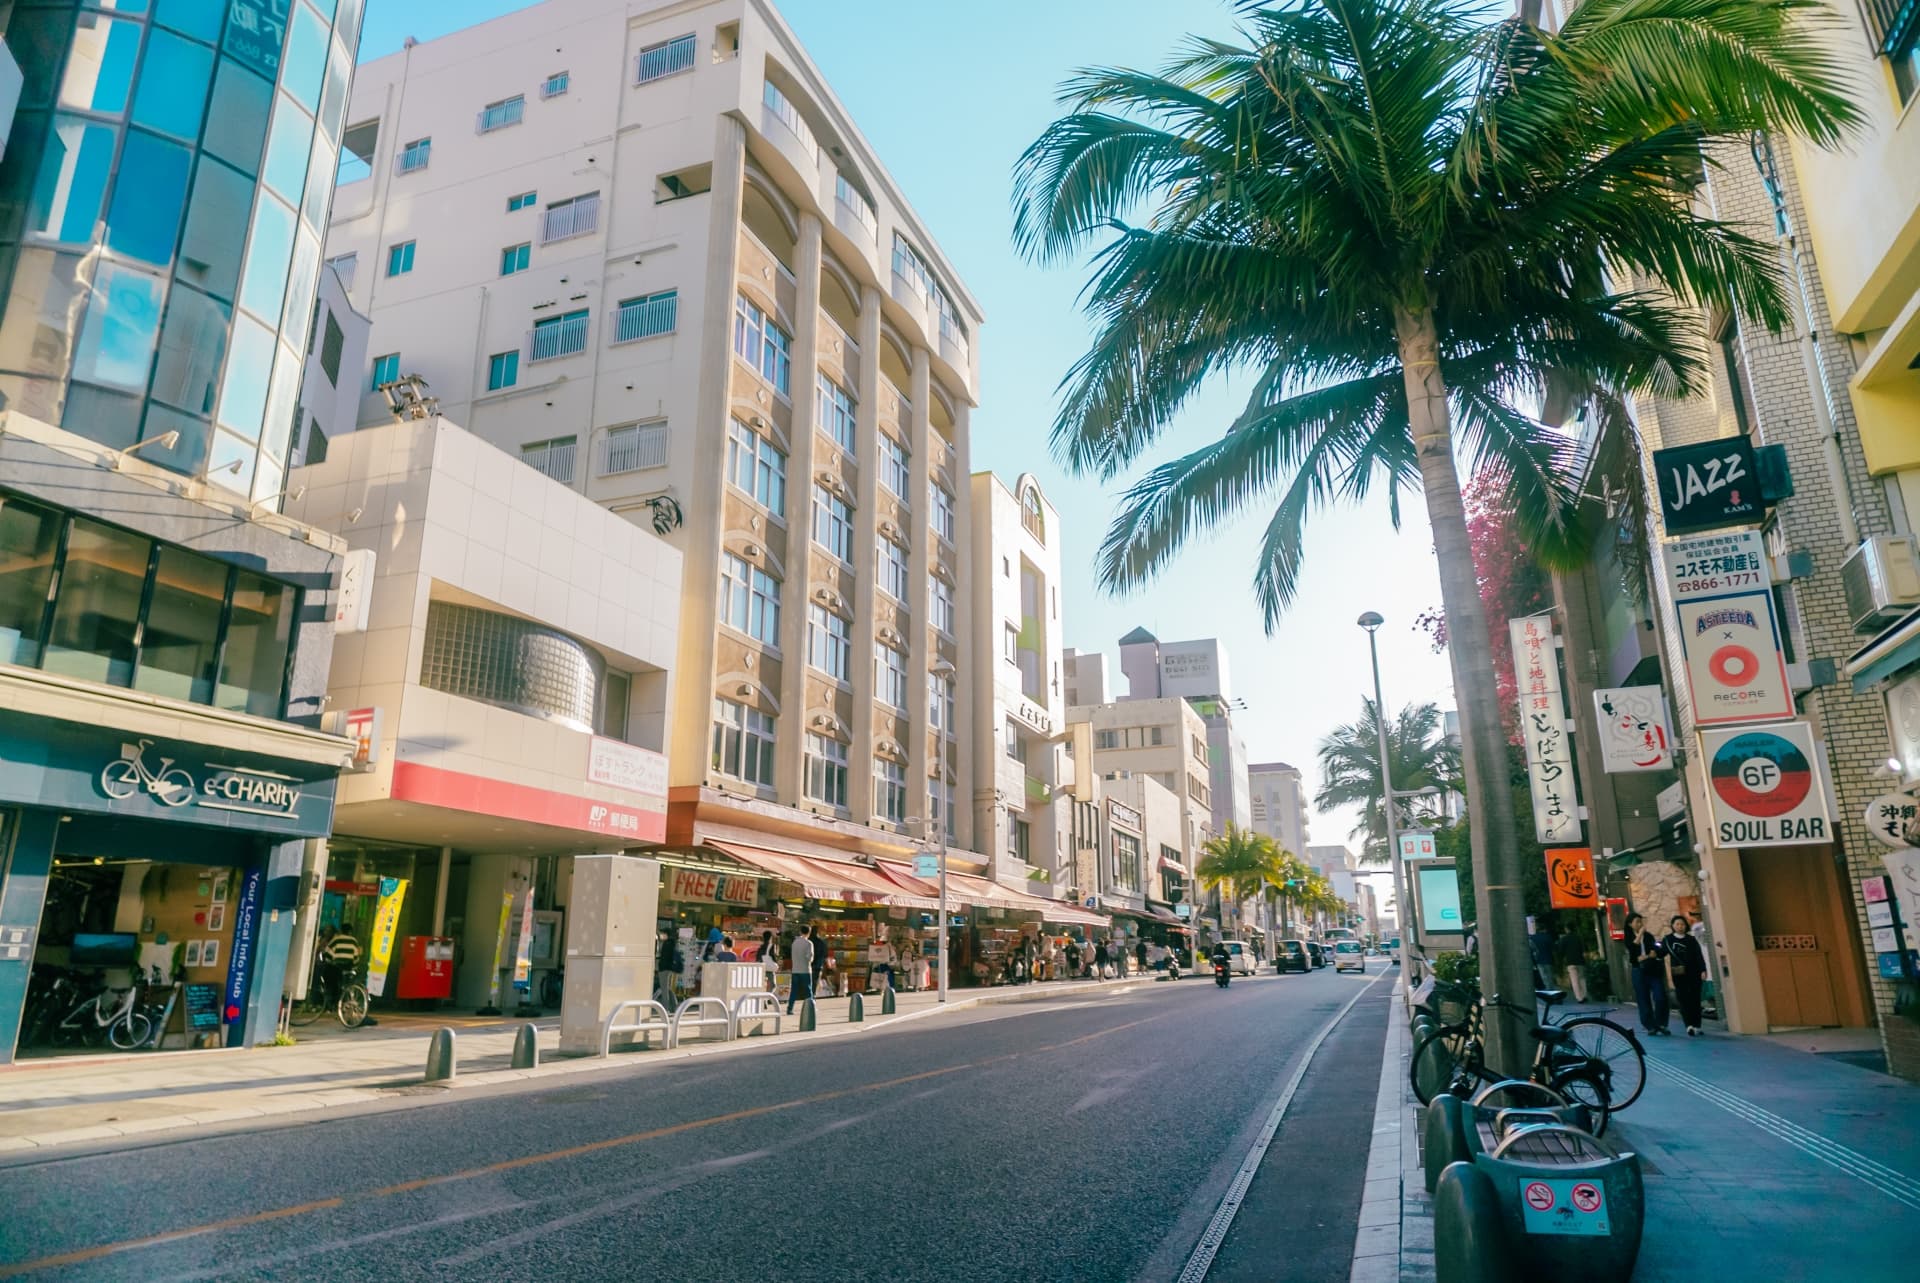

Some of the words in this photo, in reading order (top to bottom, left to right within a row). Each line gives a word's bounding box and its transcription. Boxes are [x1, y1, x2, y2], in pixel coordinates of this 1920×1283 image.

[1670, 453, 1746, 511] JAZZ
[1723, 503, 1753, 514] KAM'S
[1685, 544, 1739, 559] 保証協会会員
[1675, 554, 1747, 578] コスモ不動産
[1692, 572, 1760, 592] 866-1771
[1696, 610, 1760, 637] ASTEEDA
[1523, 621, 1550, 710] 島唄と地料理
[1743, 765, 1776, 787] 6F
[1720, 820, 1774, 842] SOUL
[1780, 817, 1825, 840] BAR
[247, 872, 260, 903] Your
[673, 871, 716, 898] FREE
[242, 905, 255, 940] Local
[237, 943, 249, 969] Info
[233, 971, 245, 998] Hub
